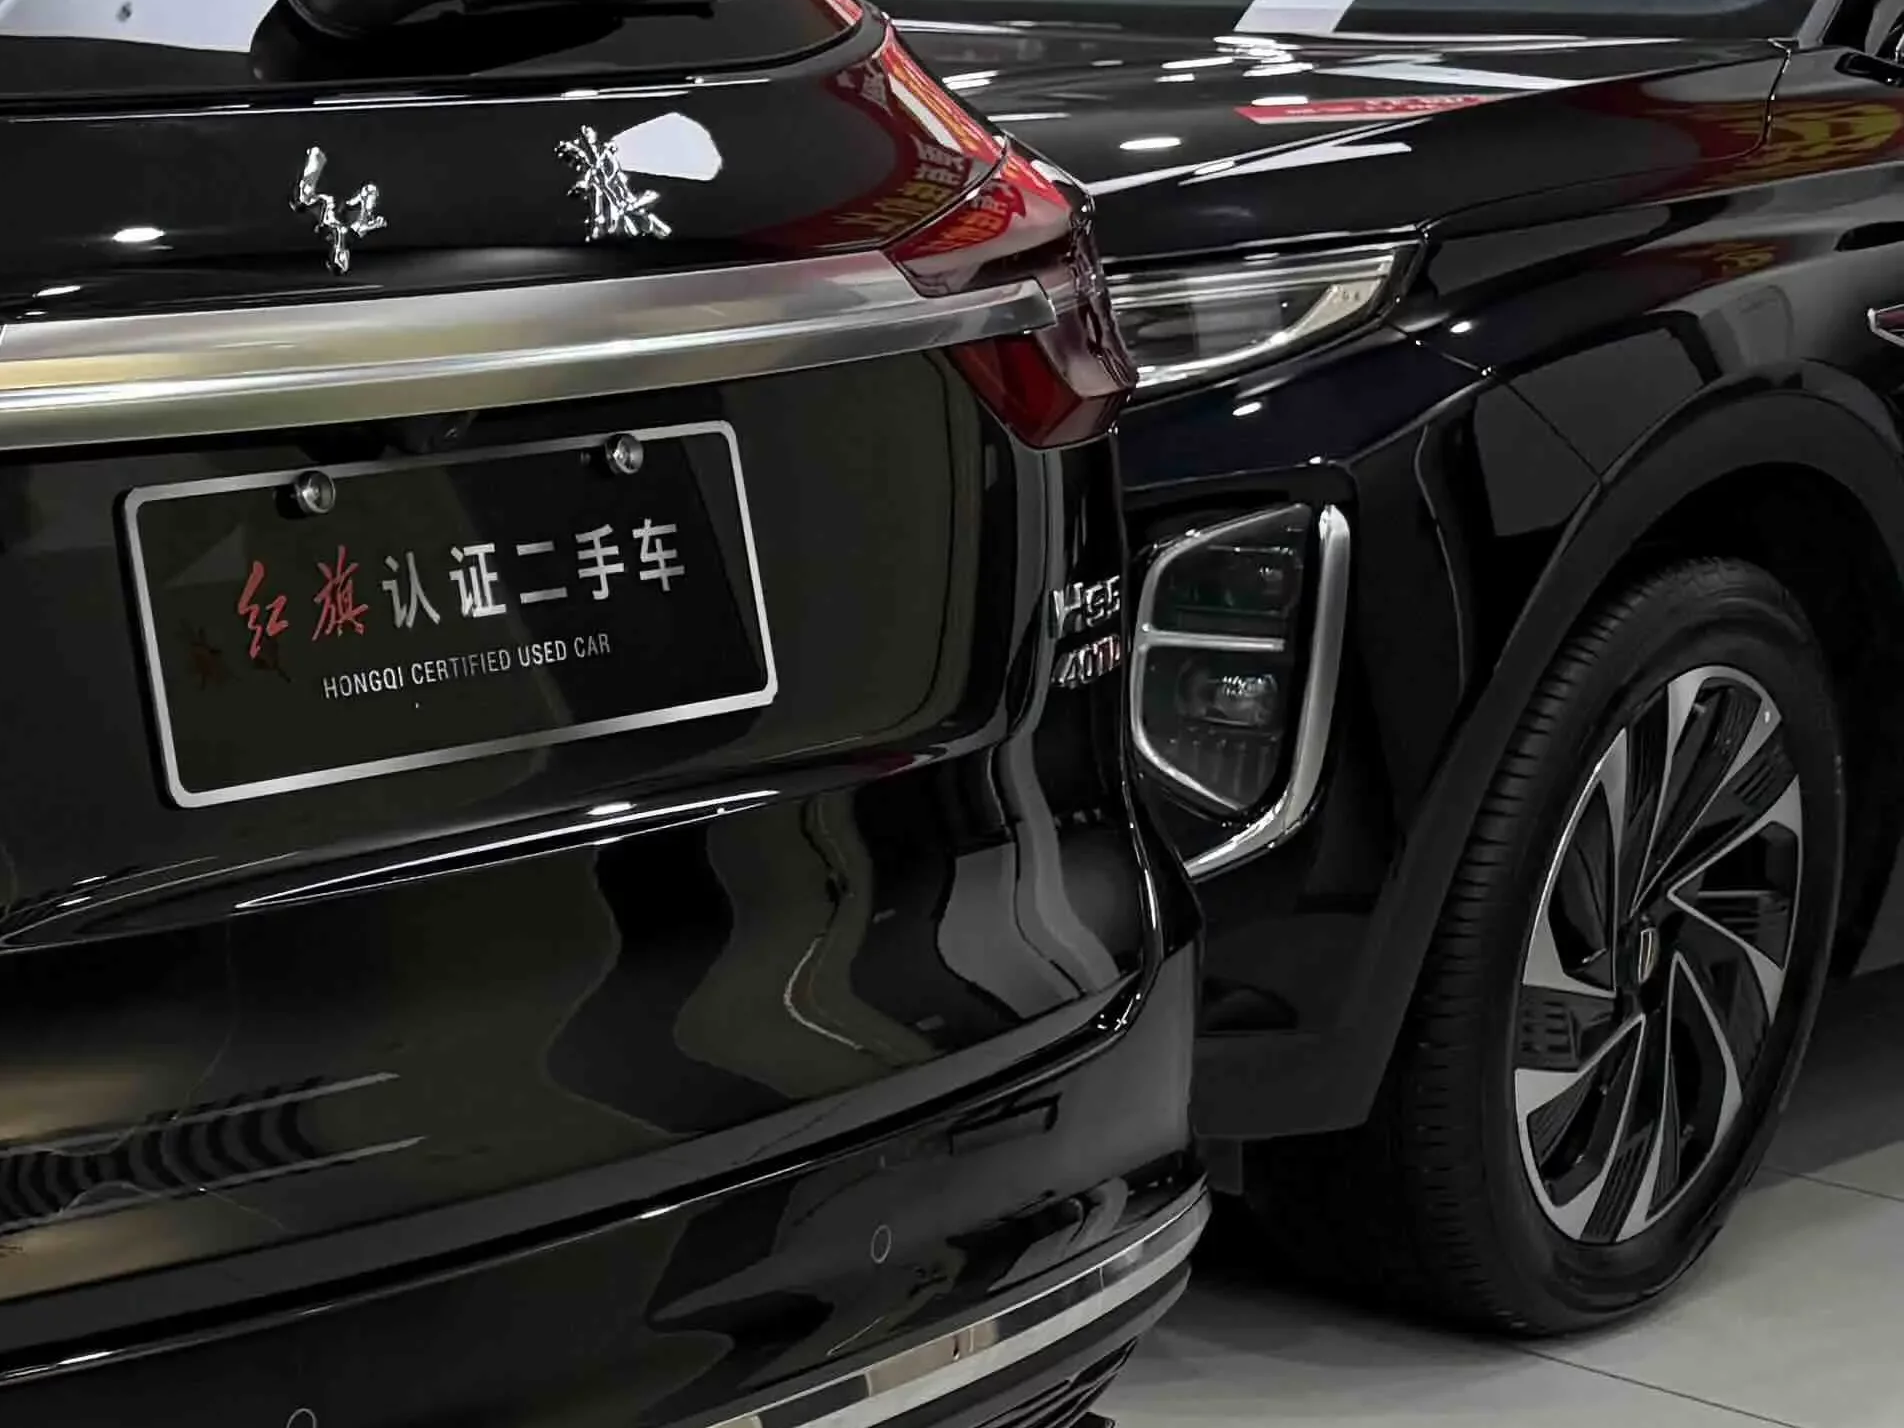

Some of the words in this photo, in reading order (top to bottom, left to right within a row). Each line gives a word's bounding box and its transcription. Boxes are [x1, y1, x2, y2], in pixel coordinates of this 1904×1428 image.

[322, 666, 407, 700] HONGQI
[409, 648, 513, 686] CERTIFIED
[517, 638, 569, 668] USED
[572, 632, 612, 660] CAR
